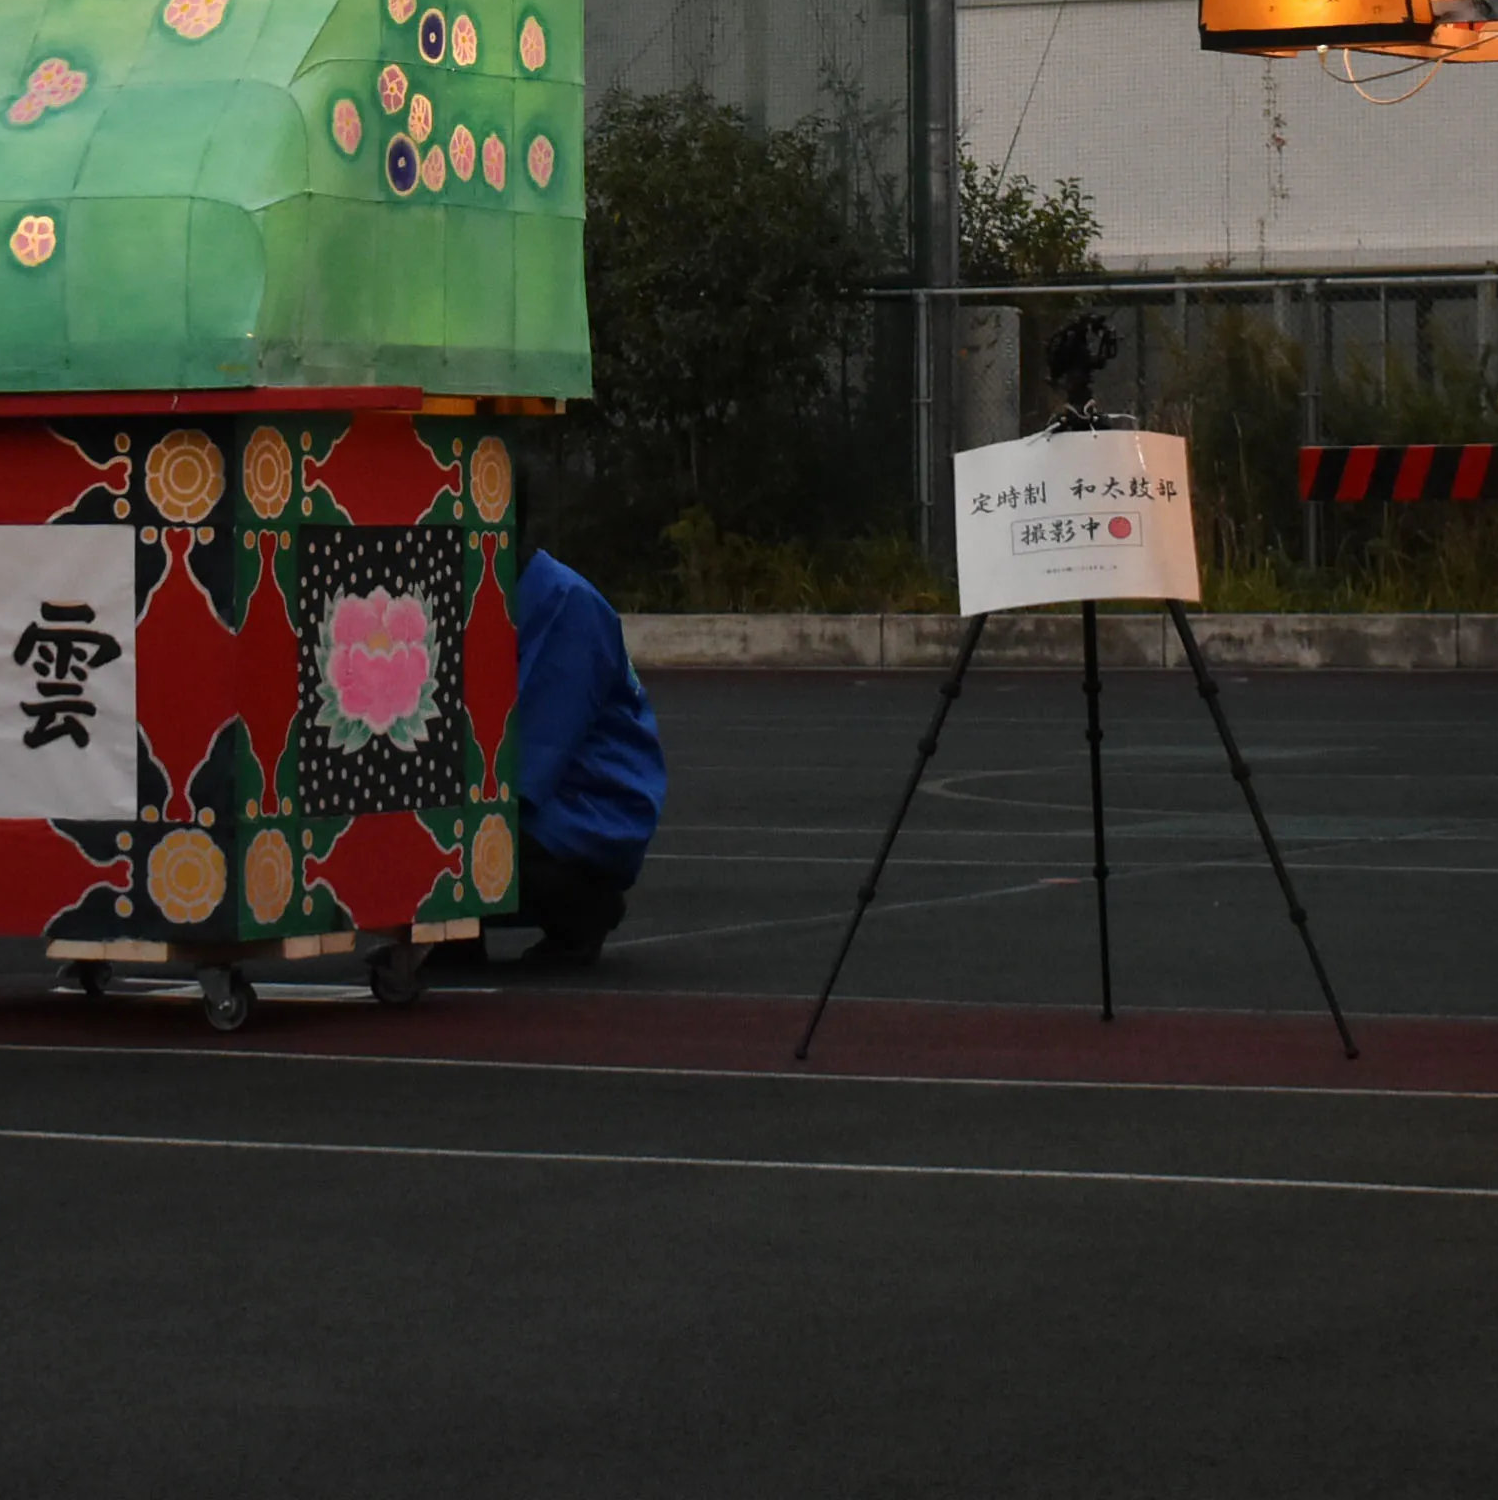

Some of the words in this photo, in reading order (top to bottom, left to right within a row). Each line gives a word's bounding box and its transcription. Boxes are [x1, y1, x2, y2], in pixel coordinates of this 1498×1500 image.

[971, 482, 1046, 515] 定時制
[1070, 477, 1178, 502] 和太鼓部
[1021, 517, 1100, 544] 撮影中
